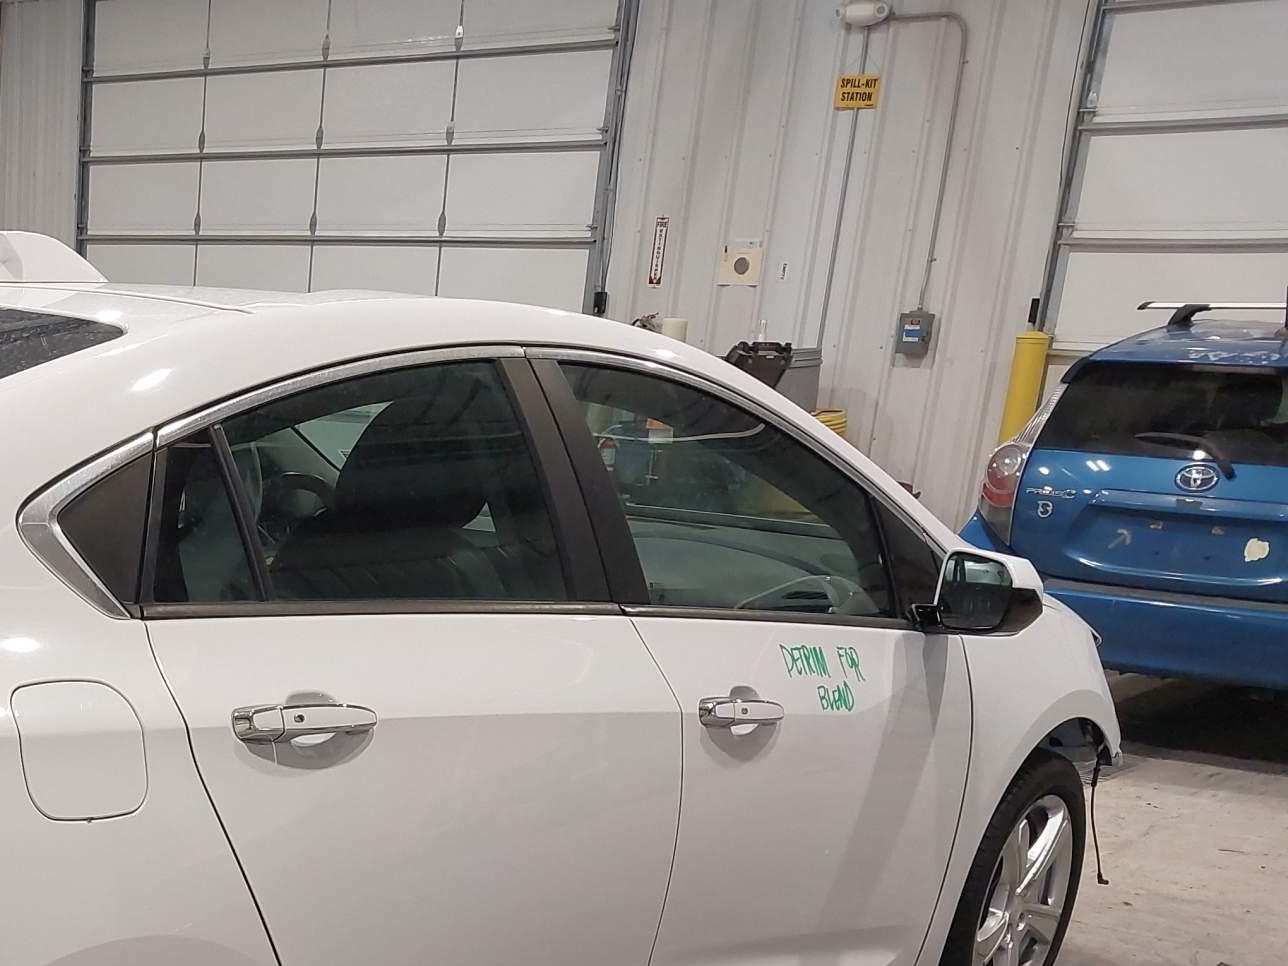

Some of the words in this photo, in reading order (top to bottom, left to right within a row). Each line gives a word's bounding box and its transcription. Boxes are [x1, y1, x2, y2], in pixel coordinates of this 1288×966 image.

[840, 78, 879, 88] SPILL-KIT
[840, 91, 873, 101] STATION
[779, 643, 831, 679] DETRIM
[836, 646, 866, 682] FOR
